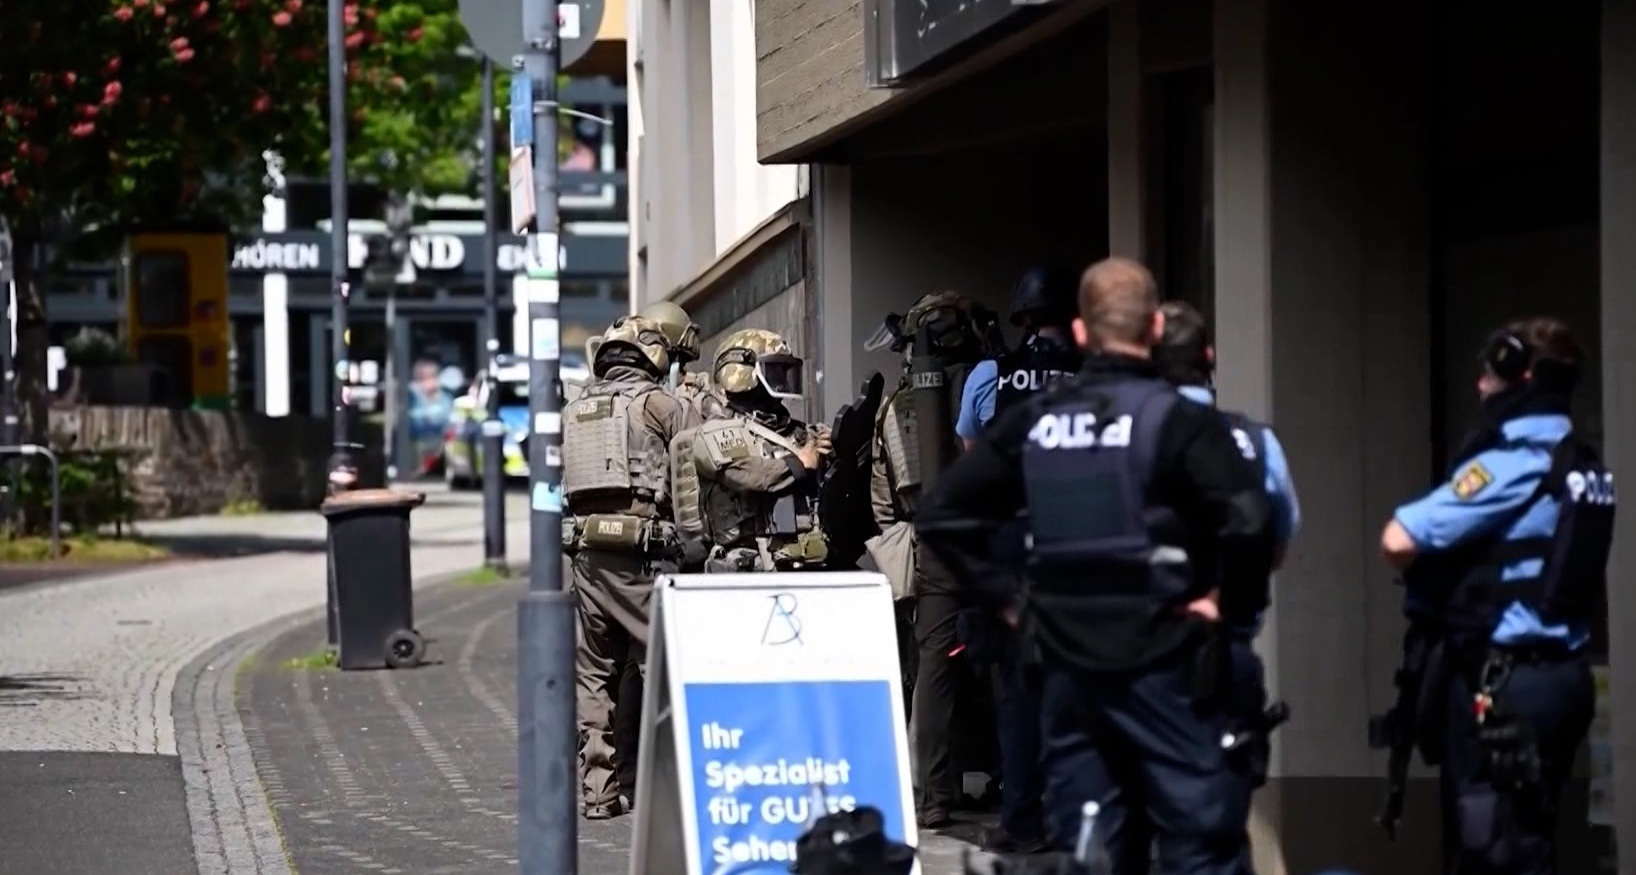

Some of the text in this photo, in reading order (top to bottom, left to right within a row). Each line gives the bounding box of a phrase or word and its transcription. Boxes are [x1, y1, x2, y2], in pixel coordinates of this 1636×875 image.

[598, 520, 623, 535] POLIZEI
[702, 721, 743, 749] Ihr
[705, 757, 851, 793] Spezialist
[708, 797, 752, 825] für
